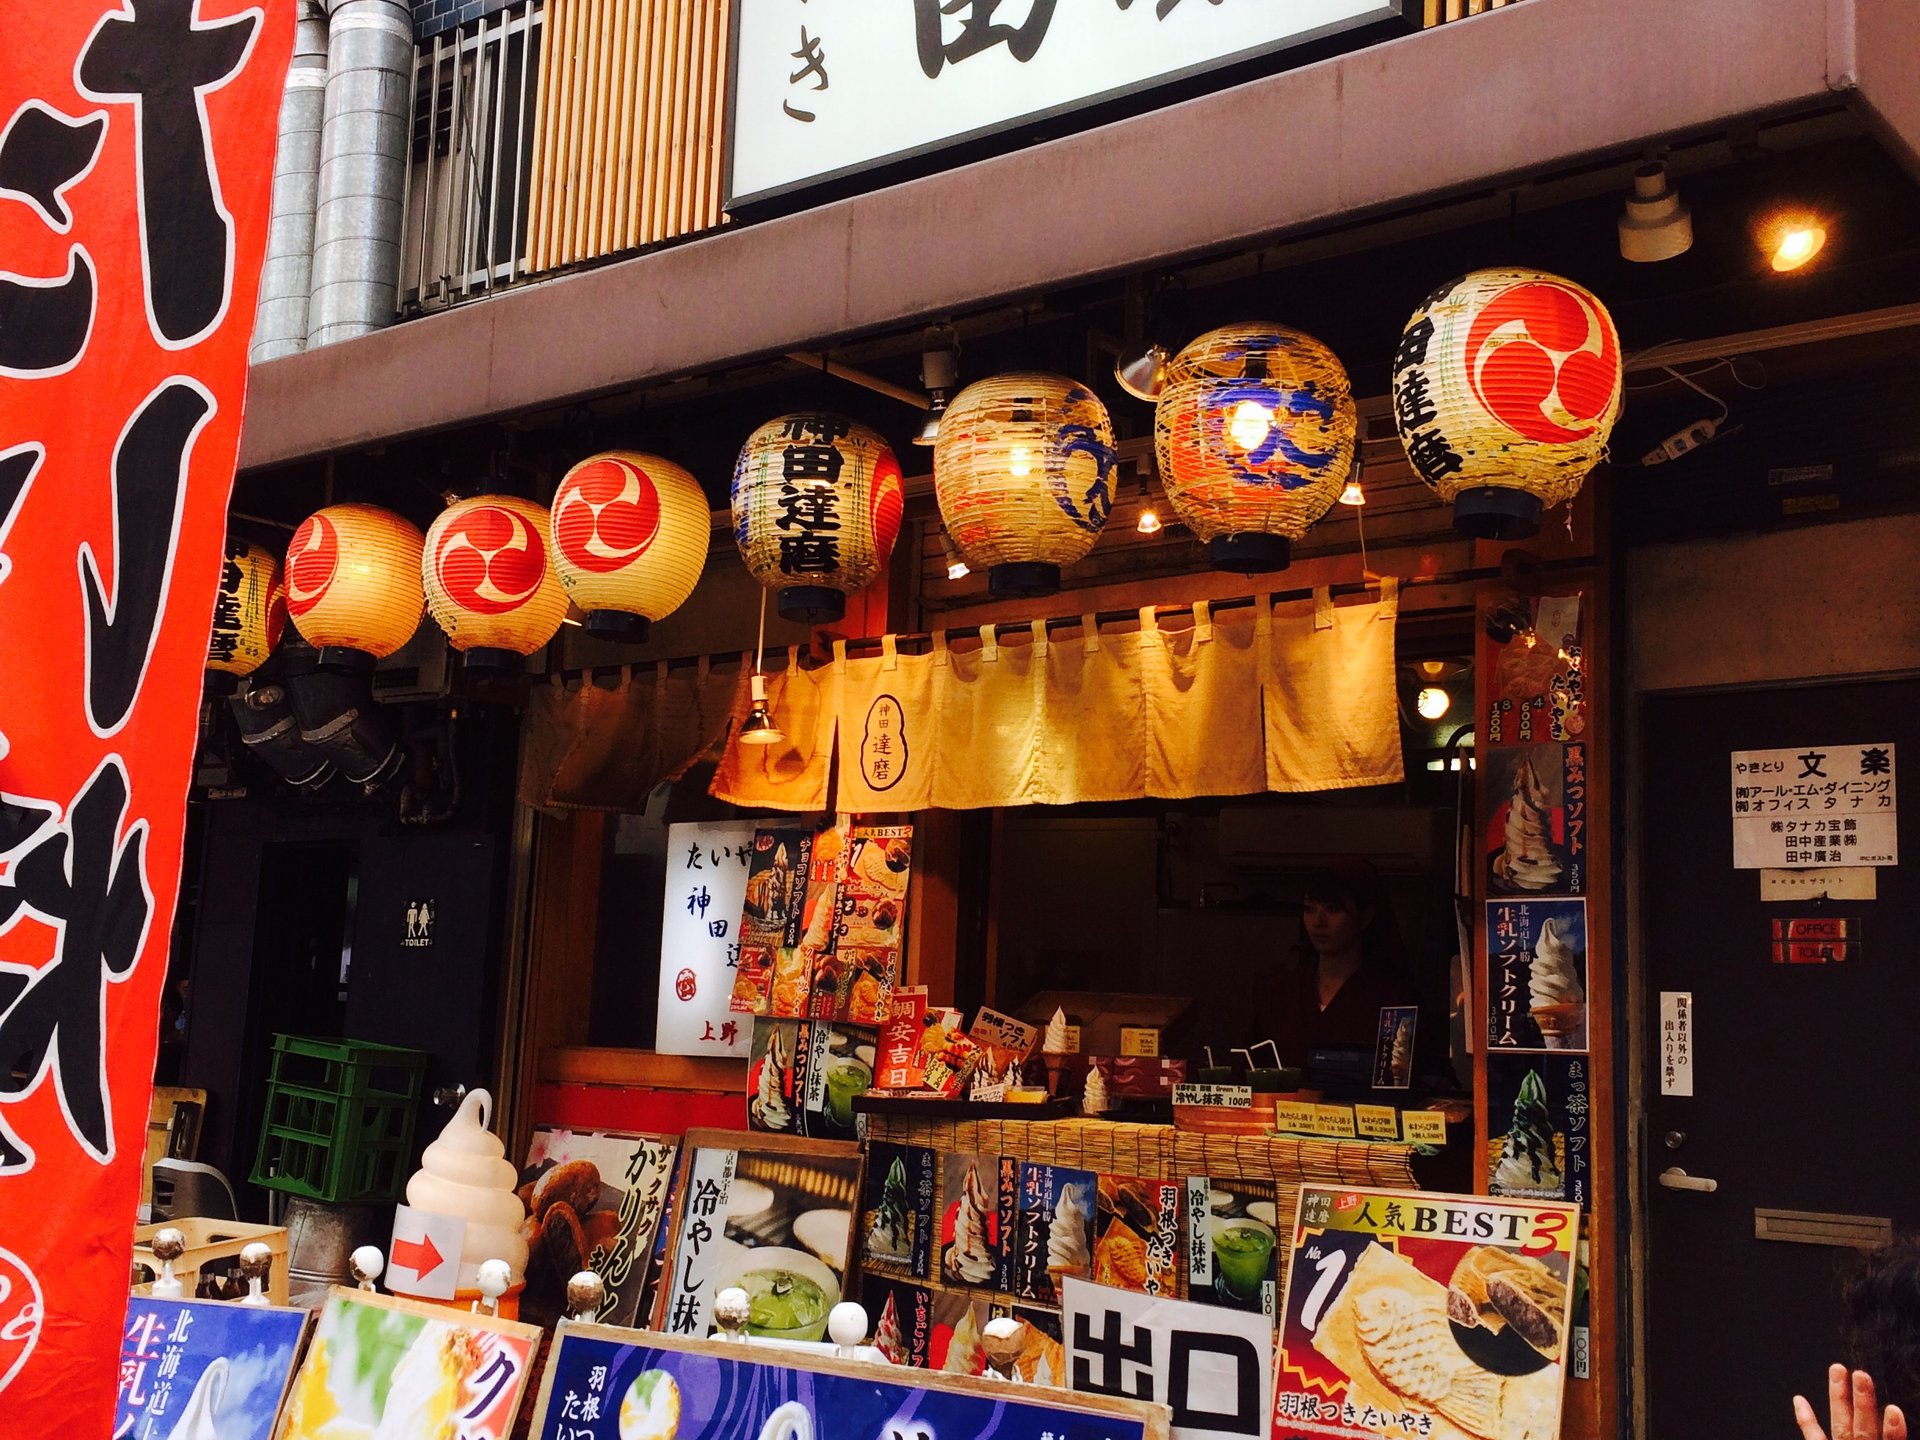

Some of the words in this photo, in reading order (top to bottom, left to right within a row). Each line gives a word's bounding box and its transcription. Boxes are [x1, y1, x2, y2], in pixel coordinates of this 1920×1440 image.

[872, 703, 893, 781] 神田達磨
[1735, 761, 1785, 774] やきとり
[1565, 746, 1584, 855] 黒みつソフト
[791, 838, 811, 919] チョコソフト
[1787, 850, 1842, 863] 田中廣治
[1796, 923, 1837, 935] OFFICE
[1797, 947, 1835, 958] TOILET
[699, 1020, 739, 1046] 上野
[794, 1023, 810, 1108] 黒みつソフト
[808, 1029, 827, 1102] 冷やし抹茶
[887, 1000, 916, 1086] 鯛安吉日
[1665, 1020, 1675, 1089] 出入りを禁ず
[1676, 997, 1688, 1066] 関係者以外の
[1175, 1092, 1224, 1106] 冷やし抹茶
[1228, 1097, 1251, 1106] 100円
[1565, 1060, 1589, 1172] まっ茶ソフト
[917, 1152, 934, 1244] まっ茶ソフト
[1000, 1159, 1014, 1257] 黒みつソフト
[1160, 1187, 1178, 1267] 羽根つき
[1303, 1208, 1330, 1224] 達磨
[1305, 1193, 1332, 1208] 神田
[1337, 1194, 1359, 1209] 上野
[1575, 1180, 1584, 1208] 350
[672, 1178, 722, 1335] 冷やし抹
[1190, 1189, 1206, 1275] 冷やし抹茶
[1304, 1246, 1322, 1260] No.
[1353, 1201, 1406, 1233] 人気
[1411, 1206, 1529, 1242] BEST
[1519, 1212, 1569, 1257] 3
[1264, 1283, 1273, 1315] 100
[1301, 1249, 1347, 1329] 1
[1073, 1309, 1261, 1437] 出口
[1279, 1393, 1433, 1436] 羽根つきたいやき
